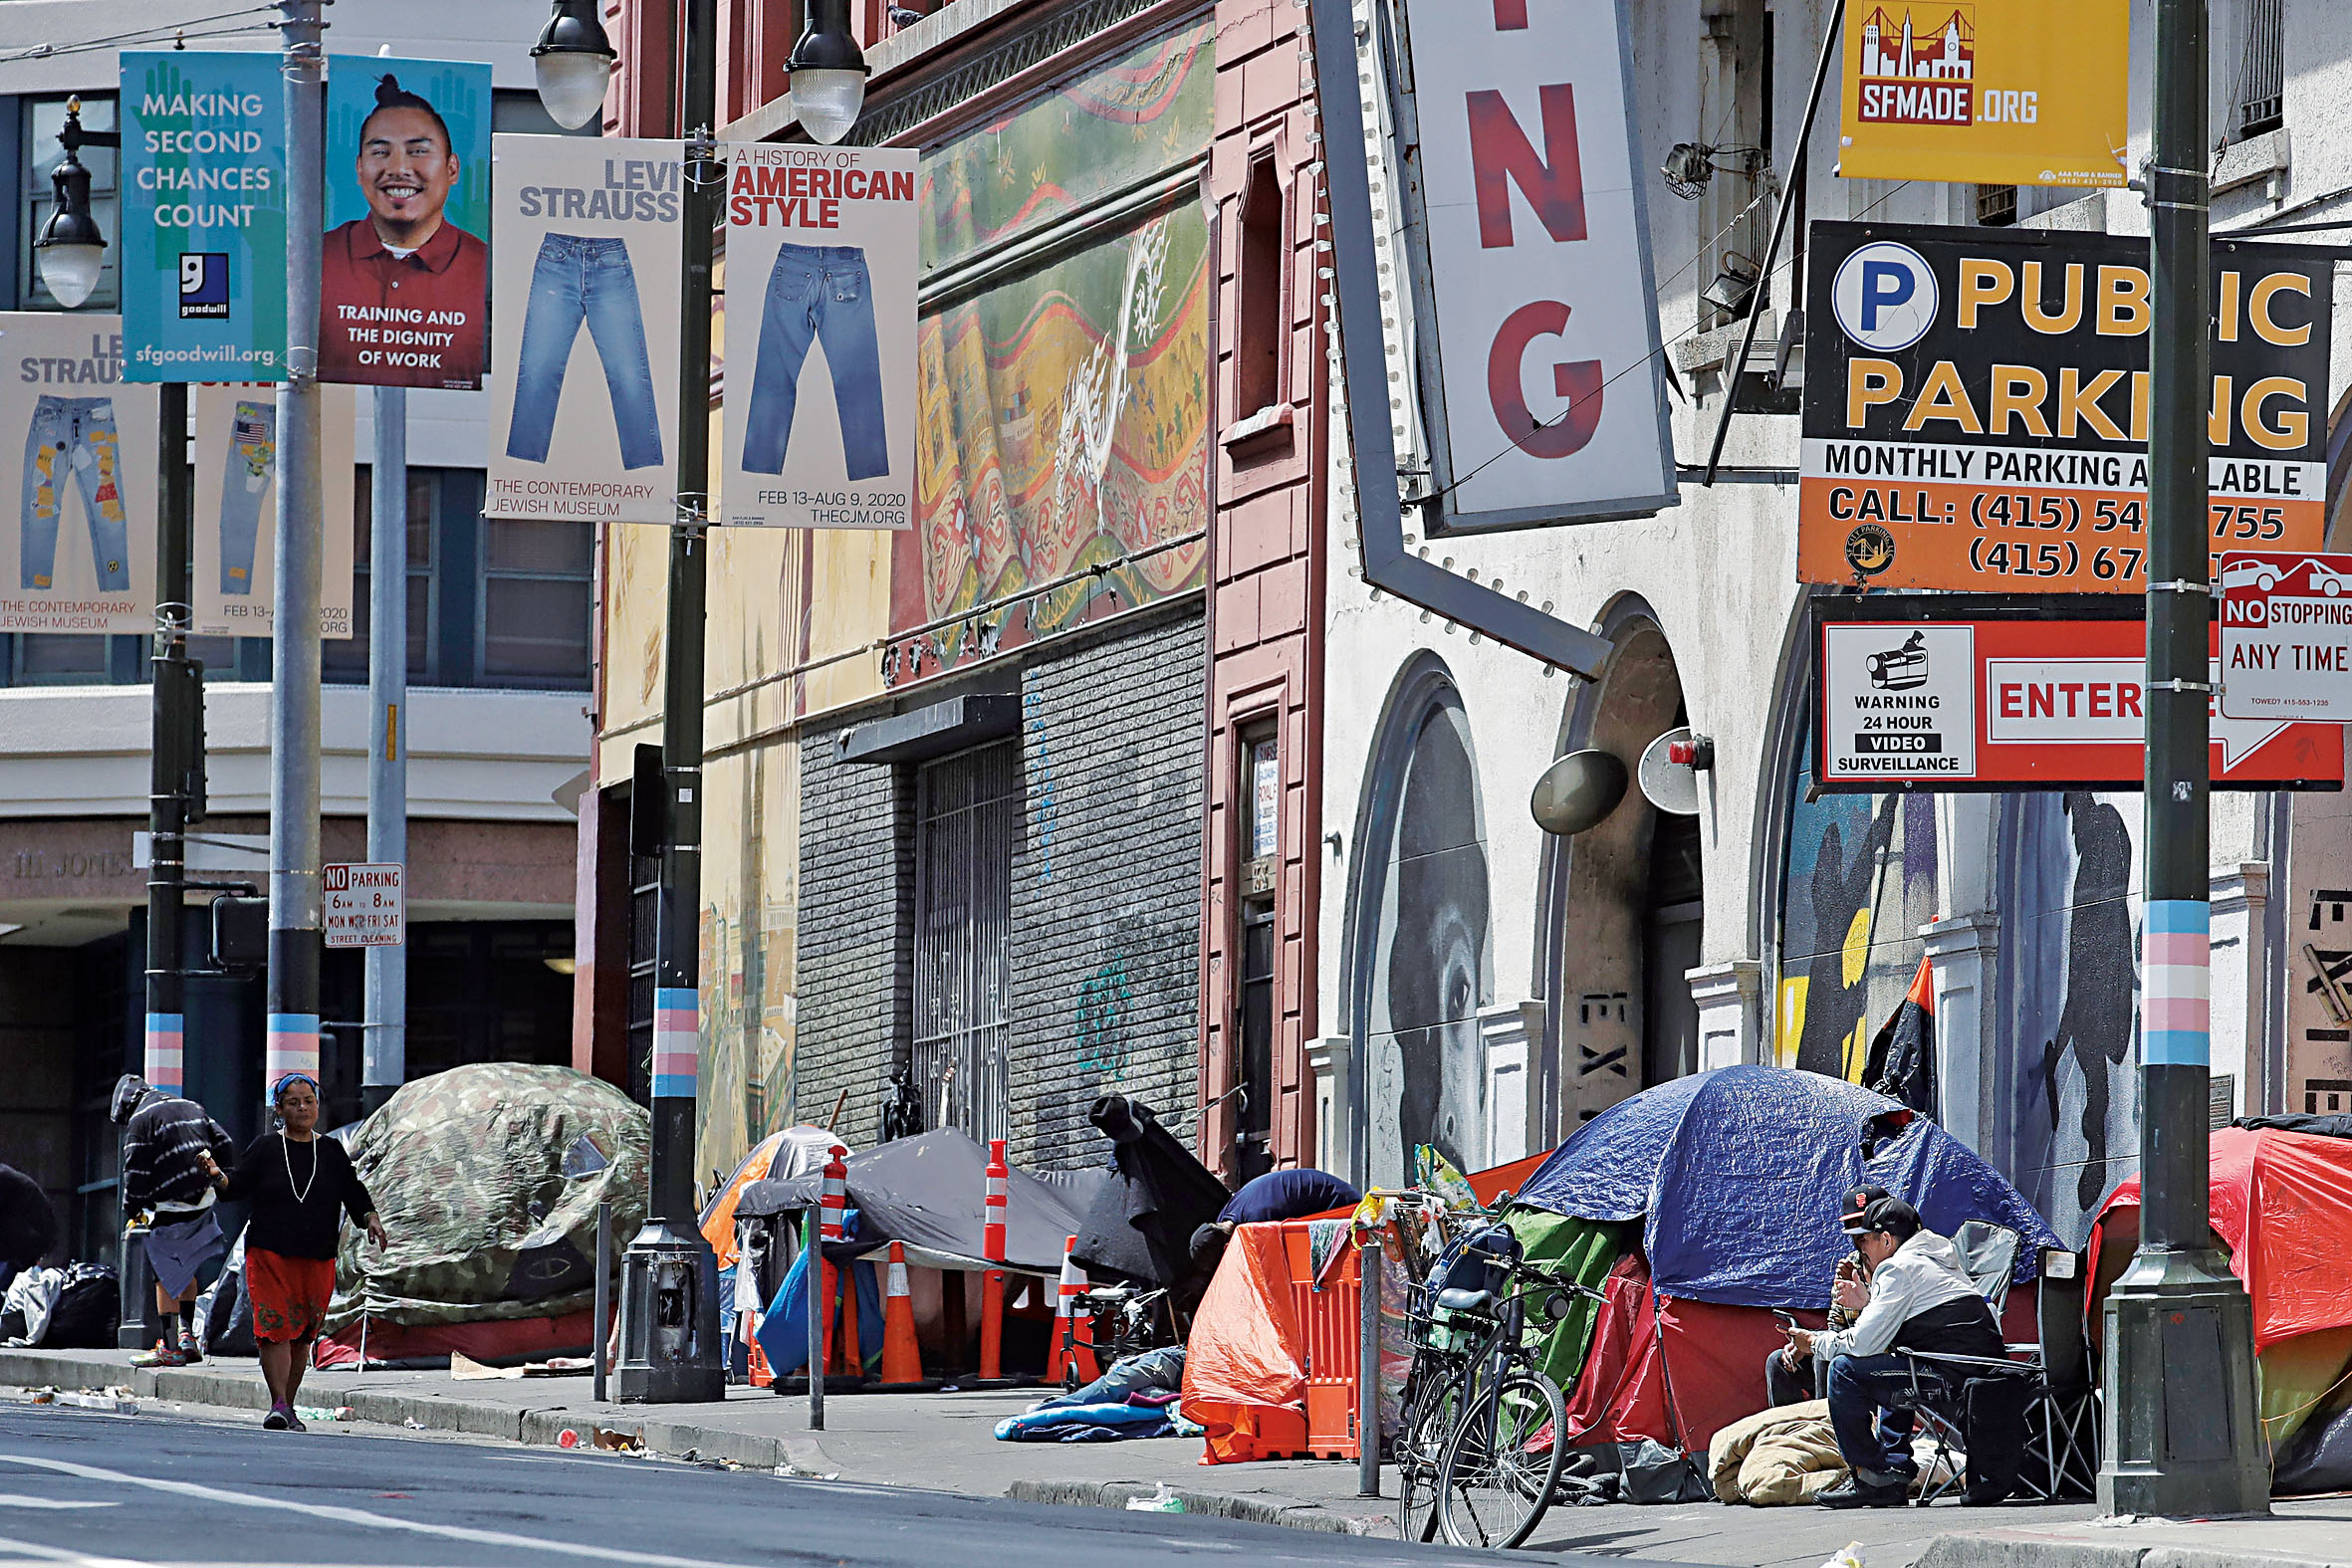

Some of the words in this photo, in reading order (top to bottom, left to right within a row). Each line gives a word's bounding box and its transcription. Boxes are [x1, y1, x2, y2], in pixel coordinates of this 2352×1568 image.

[141, 94, 264, 116] MAKING
[144, 130, 262, 153] SECOND
[735, 149, 748, 165] A
[753, 150, 832, 167] HISTORY
[835, 152, 861, 168] OF
[136, 167, 271, 190] CHANCES
[604, 158, 679, 192] LEVI
[730, 166, 915, 201] AMERICAN
[520, 186, 679, 223] STRAUSS
[730, 196, 839, 229] STYLE
[153, 204, 255, 228] COUNT
[1465, 0, 1603, 460] NG
[1860, 260, 1916, 332] P
[1957, 257, 2313, 347] PUBIC
[182, 304, 227, 317] goodwill
[337, 305, 423, 324] TRAINING
[426, 312, 466, 326] AND
[93, 335, 121, 358] LE
[348, 328, 378, 343] THE
[382, 330, 454, 347] DIGNITY
[135, 344, 275, 366] sfgoodwill.org
[357, 349, 382, 365] OF
[385, 350, 442, 368] WORK
[21, 357, 149, 384] STRAU
[1825, 444, 1975, 479] MONTHLY
[1985, 452, 2121, 487] PARKING
[2129, 459, 2301, 495] AABLE
[493, 479, 523, 494] THE
[527, 481, 654, 499] CONTEMPORARY
[758, 491, 787, 504] FEB
[850, 493, 862, 507] 9,
[867, 493, 906, 507] 2020
[492, 499, 549, 513] JEWISH
[554, 501, 620, 516] MUSEUM
[811, 509, 905, 525] THECJM.ORG
[1828, 487, 1956, 525] CALL:
[1970, 493, 2081, 533] (415)
[1968, 537, 2079, 576] (415)
[0, 600, 25, 612] THE
[29, 600, 136, 614] CONTEMPORARY
[224, 605, 248, 617] FEB
[2226, 599, 2266, 623] NO
[2271, 602, 2352, 625] STOPPING
[0, 615, 48, 627] JEWISH
[52, 617, 108, 628] MUSEUM
[2231, 643, 2281, 669] ANY
[2291, 645, 2349, 672] TIME
[1855, 696, 1940, 709] WARNING
[1999, 682, 2144, 718] ENTER
[1863, 716, 1882, 730] 24
[1887, 716, 1933, 730] HOUR
[1870, 736, 1926, 751] VIDEO
[1838, 758, 1959, 771] SURVEILLANCE
[327, 868, 346, 888] NO
[352, 872, 398, 887] PARKING
[329, 915, 346, 928] MON
[367, 915, 380, 928] FRI
[383, 914, 399, 928] SAT
[331, 935, 357, 944] STREET
[361, 935, 396, 944] CLEANING
